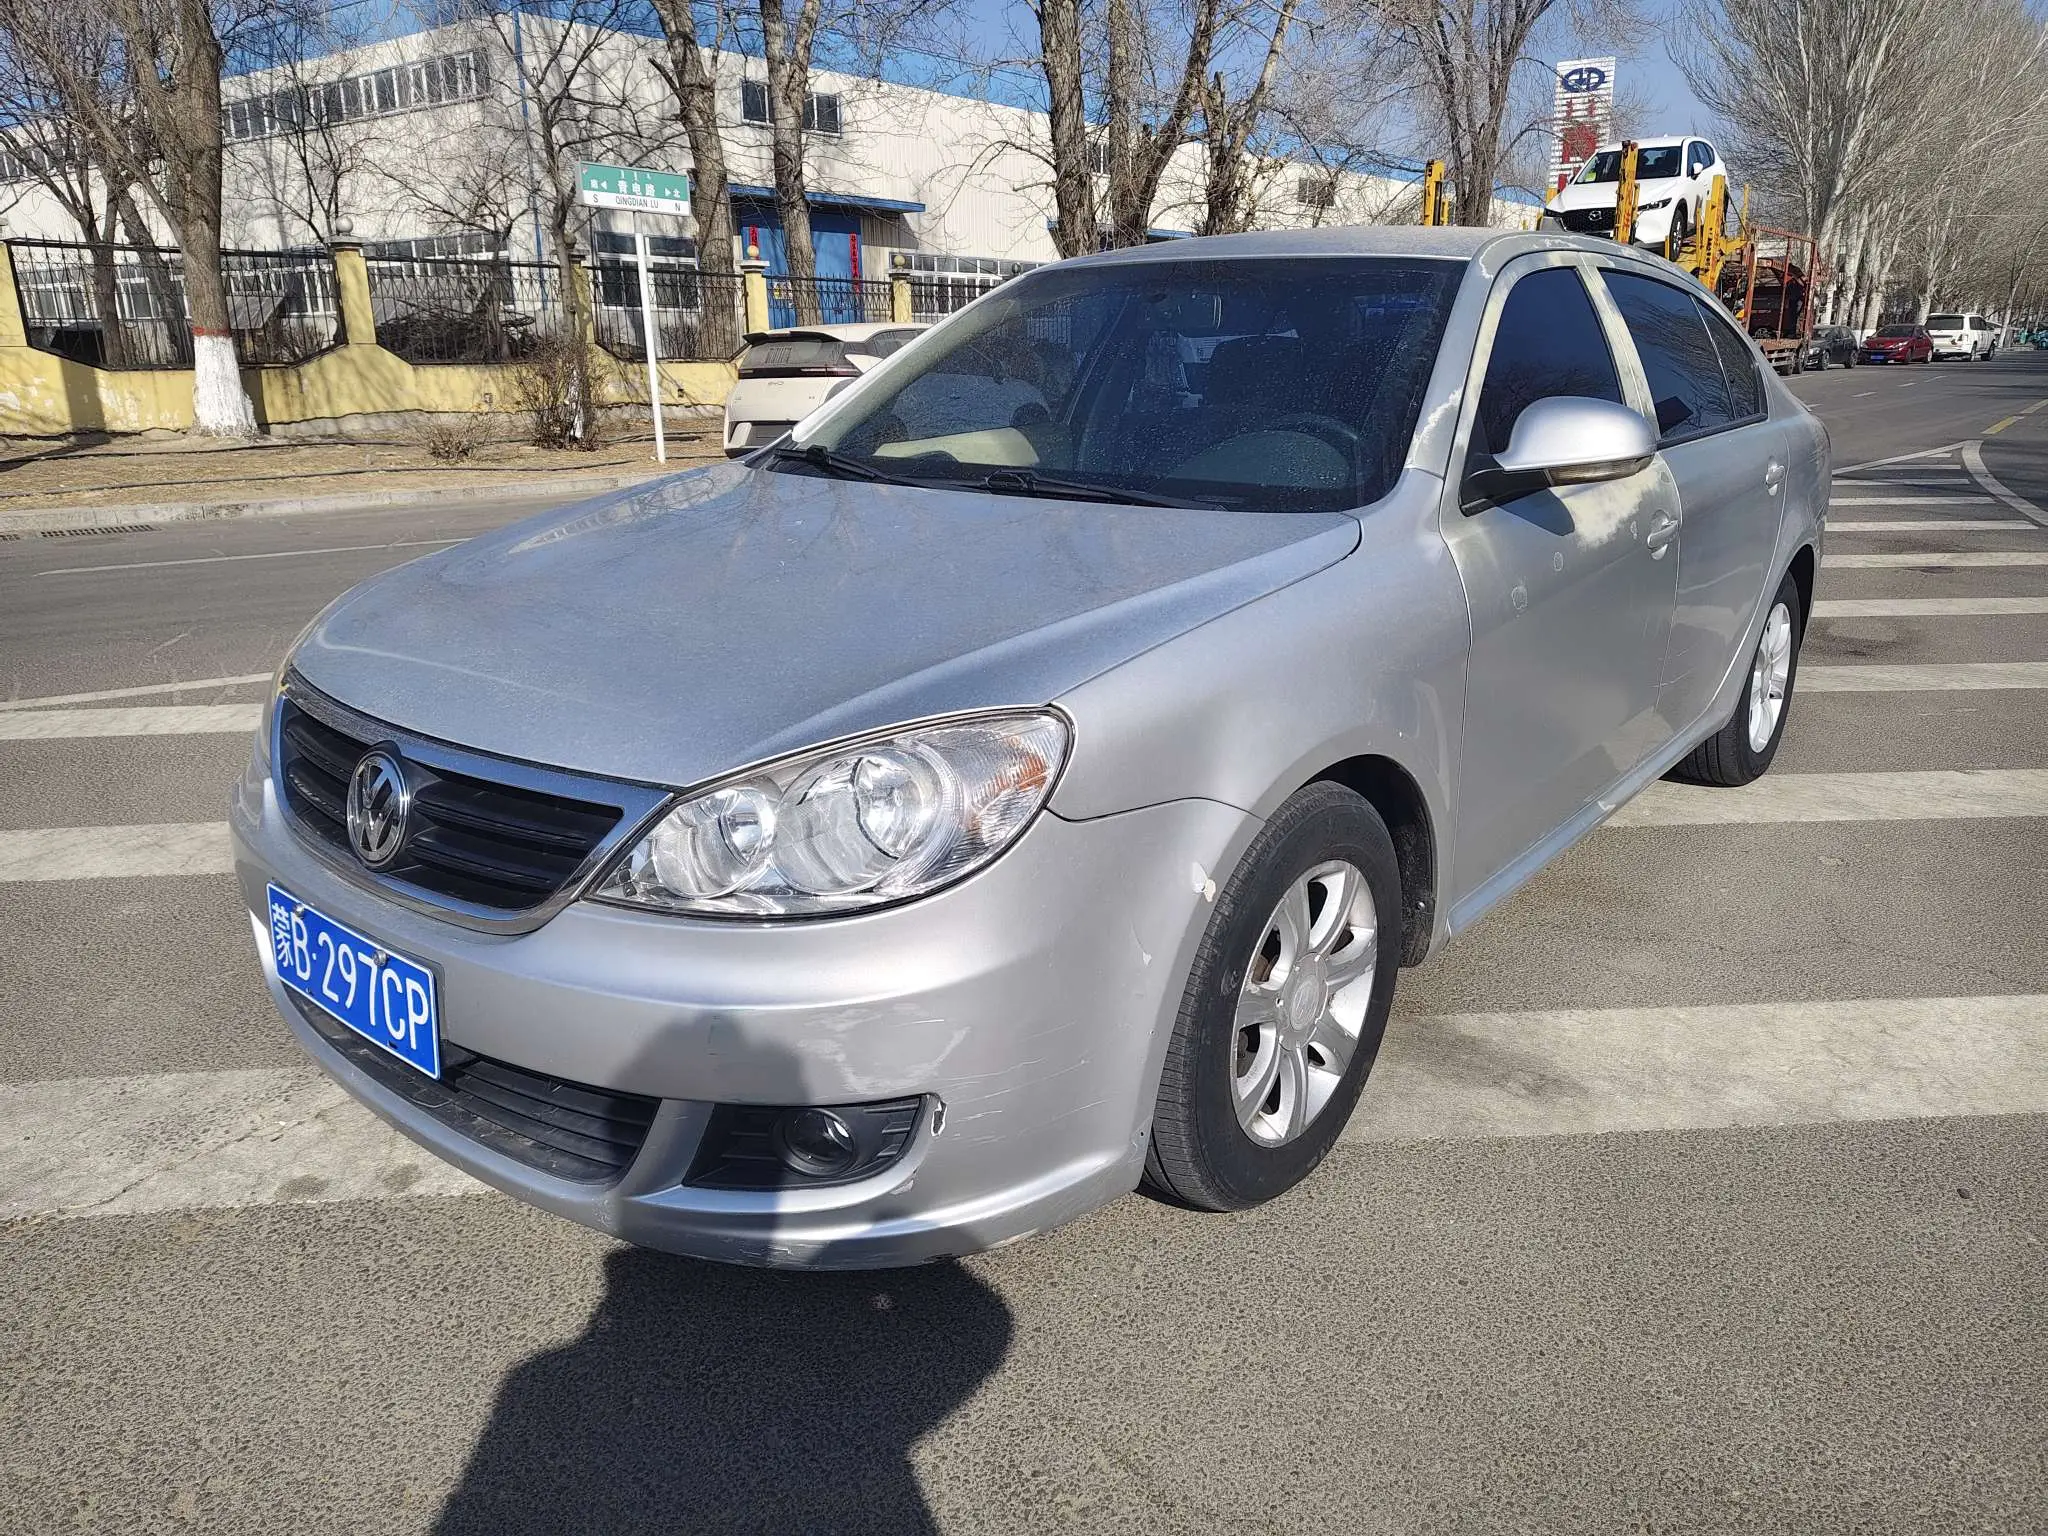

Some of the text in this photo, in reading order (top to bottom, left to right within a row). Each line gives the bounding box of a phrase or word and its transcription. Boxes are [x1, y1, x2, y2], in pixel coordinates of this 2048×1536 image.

[618, 180, 655, 197] 青电路
[673, 188, 681, 198] 北
[593, 194, 681, 211] S QINGDIAN LU N
